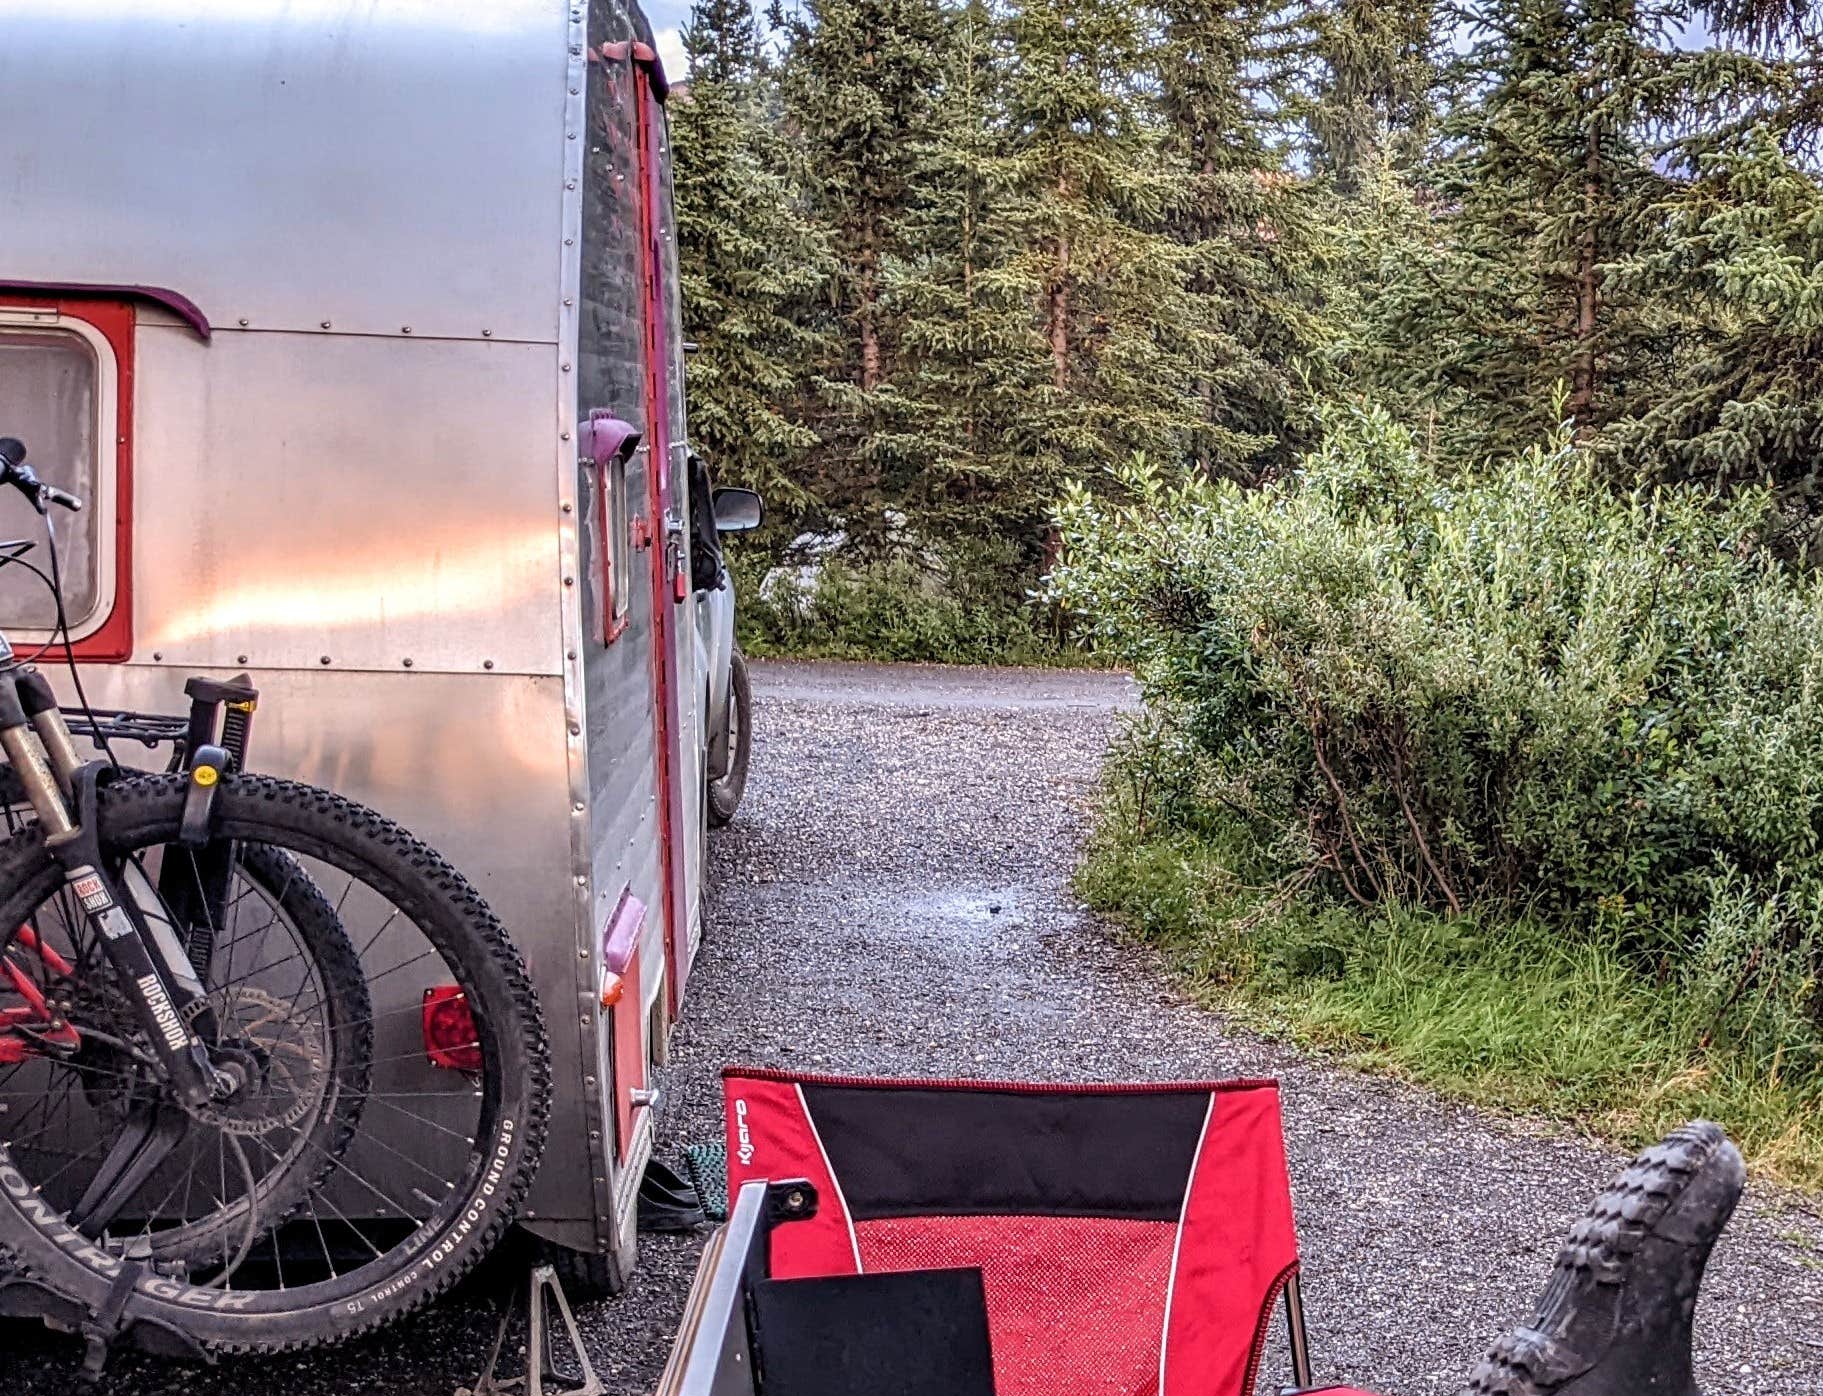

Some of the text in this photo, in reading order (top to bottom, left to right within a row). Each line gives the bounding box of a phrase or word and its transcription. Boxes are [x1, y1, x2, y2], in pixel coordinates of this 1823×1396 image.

[75, 878, 102, 896] ROCK
[83, 892, 110, 911] SHOX
[137, 973, 189, 1051] ROCKSHOX
[482, 1119, 514, 1196] GROUND
[422, 1198, 487, 1269] CONTROL
[371, 1271, 418, 1303] CONTROL
